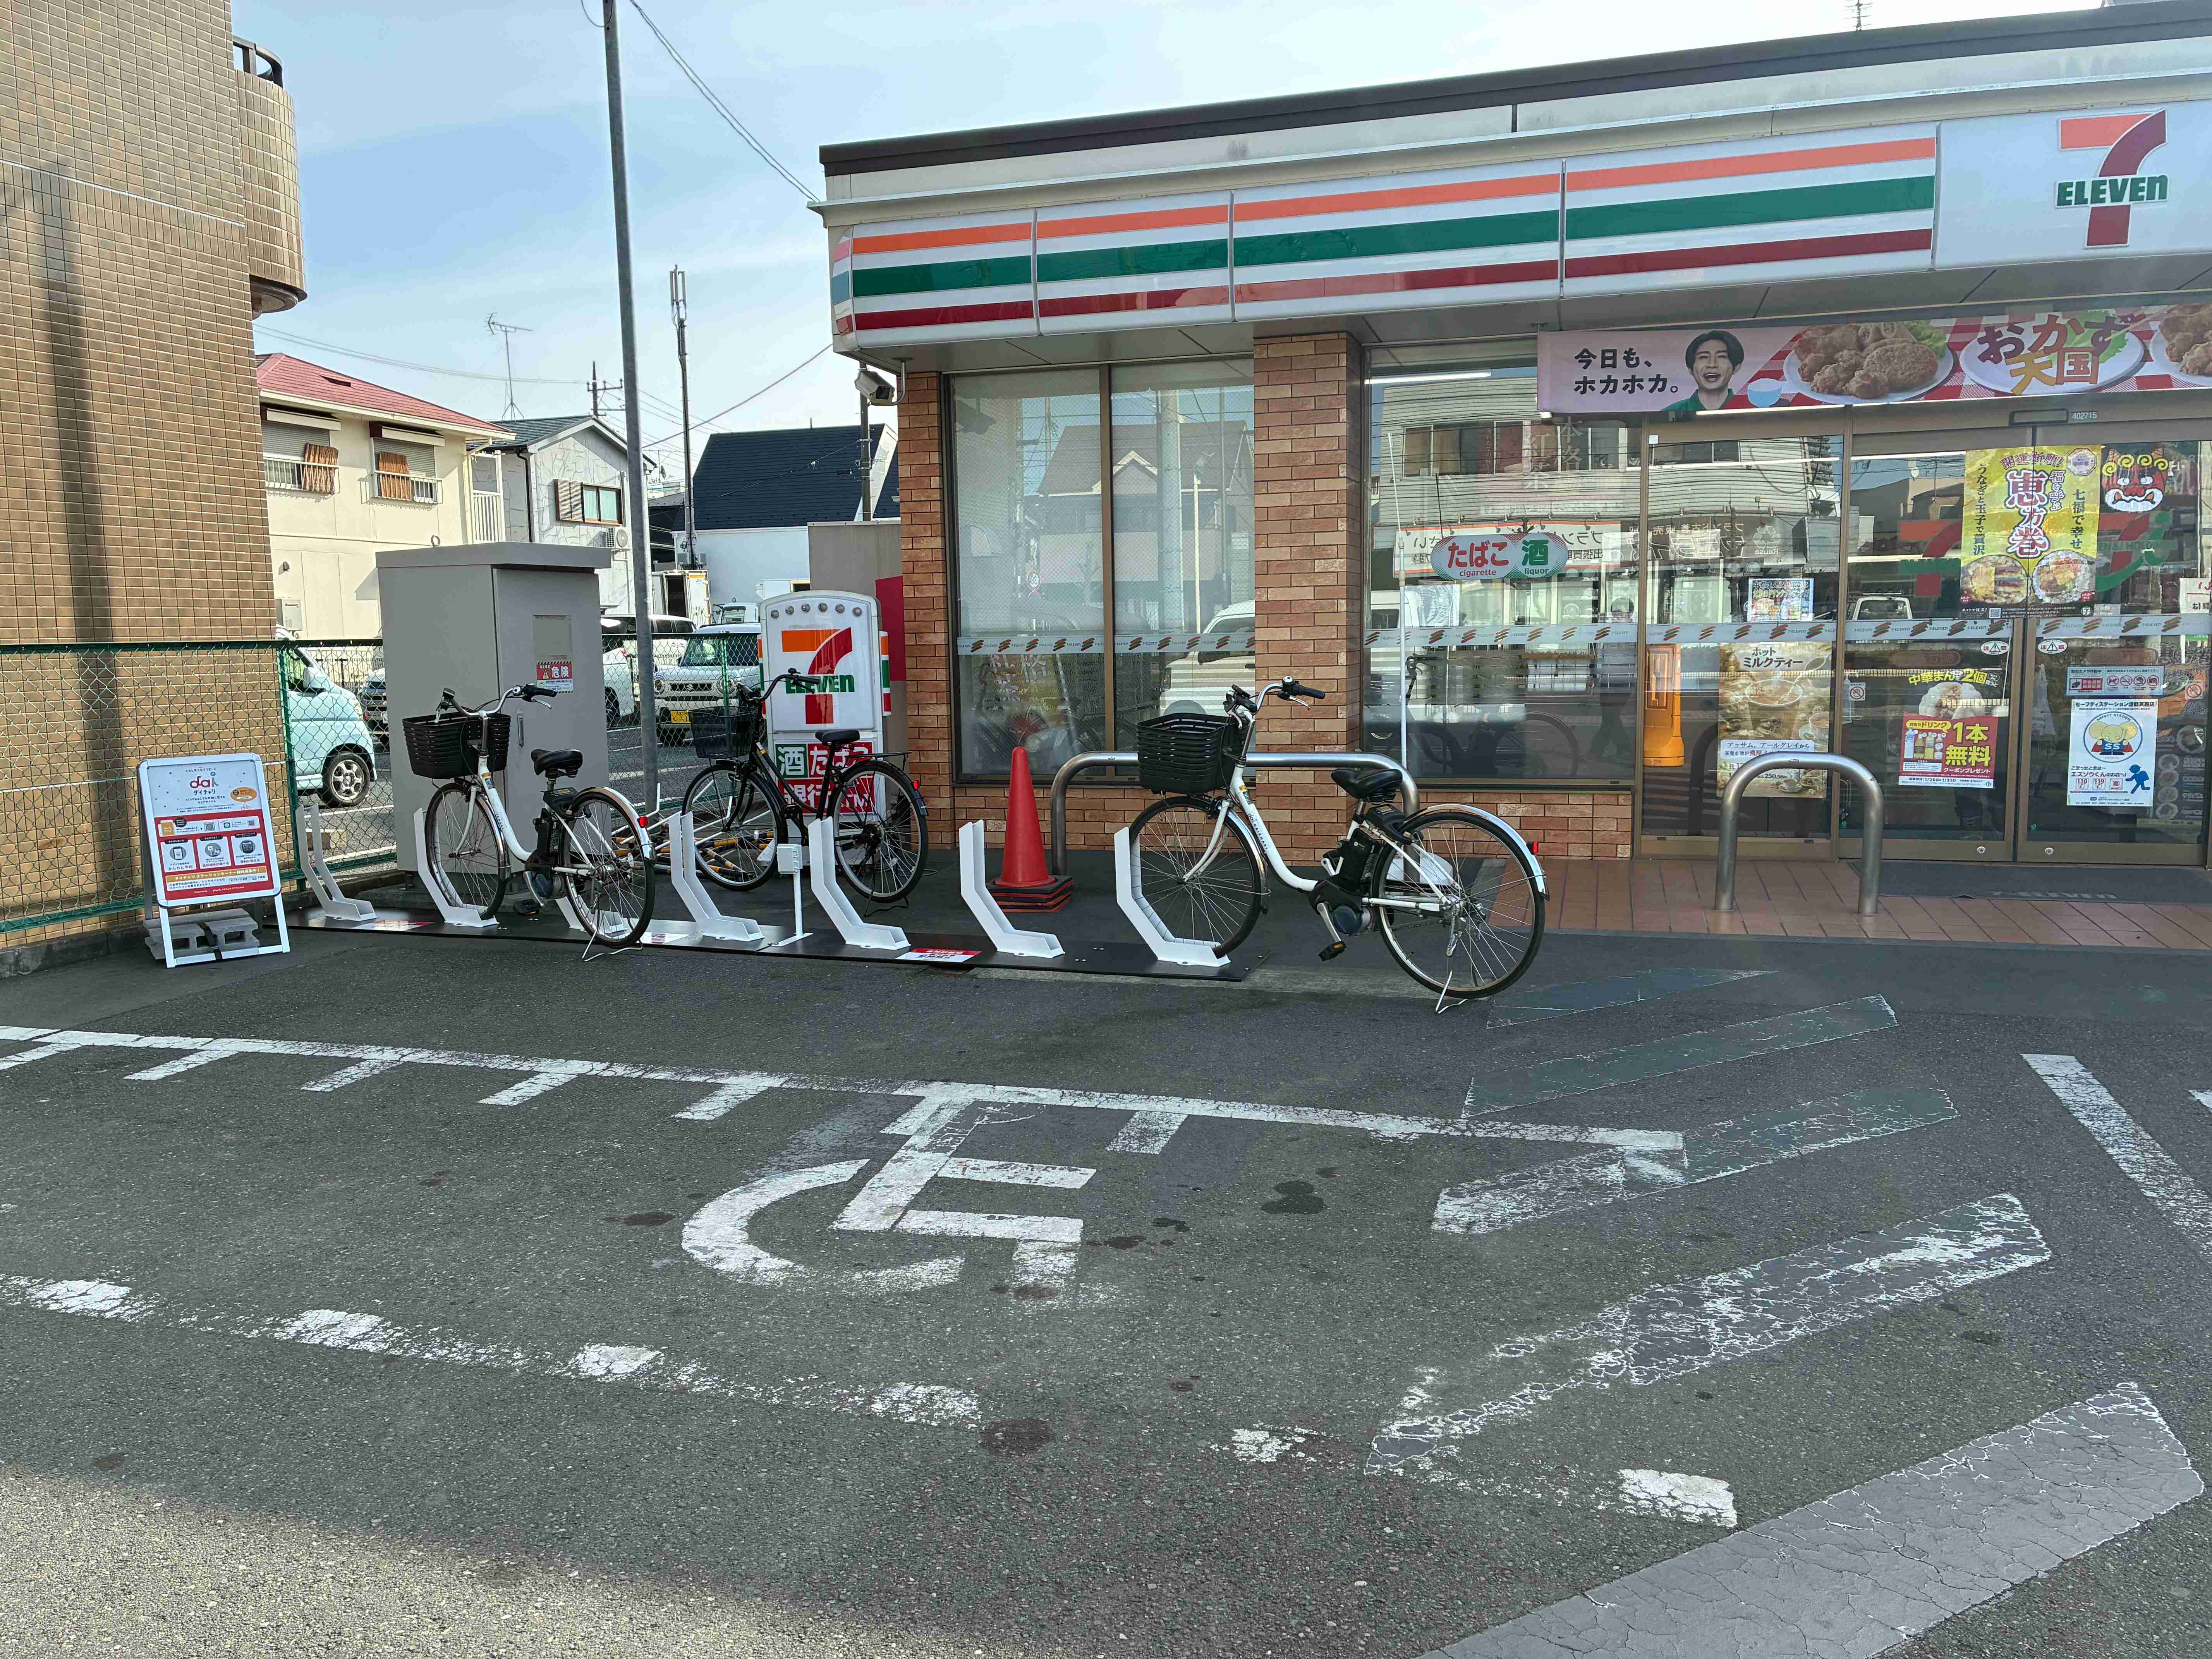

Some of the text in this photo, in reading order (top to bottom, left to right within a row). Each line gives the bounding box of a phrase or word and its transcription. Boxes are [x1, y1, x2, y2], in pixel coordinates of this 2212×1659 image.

[1574, 347, 1652, 369] 今日も、
[2005, 347, 2099, 395] 天国
[1574, 374, 1678, 395] ホカホカ。
[2005, 469, 2051, 559] 恵方巻
[2071, 489, 2086, 549] 七福で幸せ
[1447, 540, 1509, 568] たばこ
[1521, 539, 1549, 566] 酒
[1459, 568, 1549, 577] cigarette liquor
[1752, 647, 1776, 656] ホット
[551, 666, 569, 678] 危険
[1743, 657, 1803, 668] ミルクティー
[1953, 722, 1989, 743] 1本
[776, 747, 805, 776] 酒
[1945, 745, 1991, 766] 無料
[189, 771, 219, 788] dai
